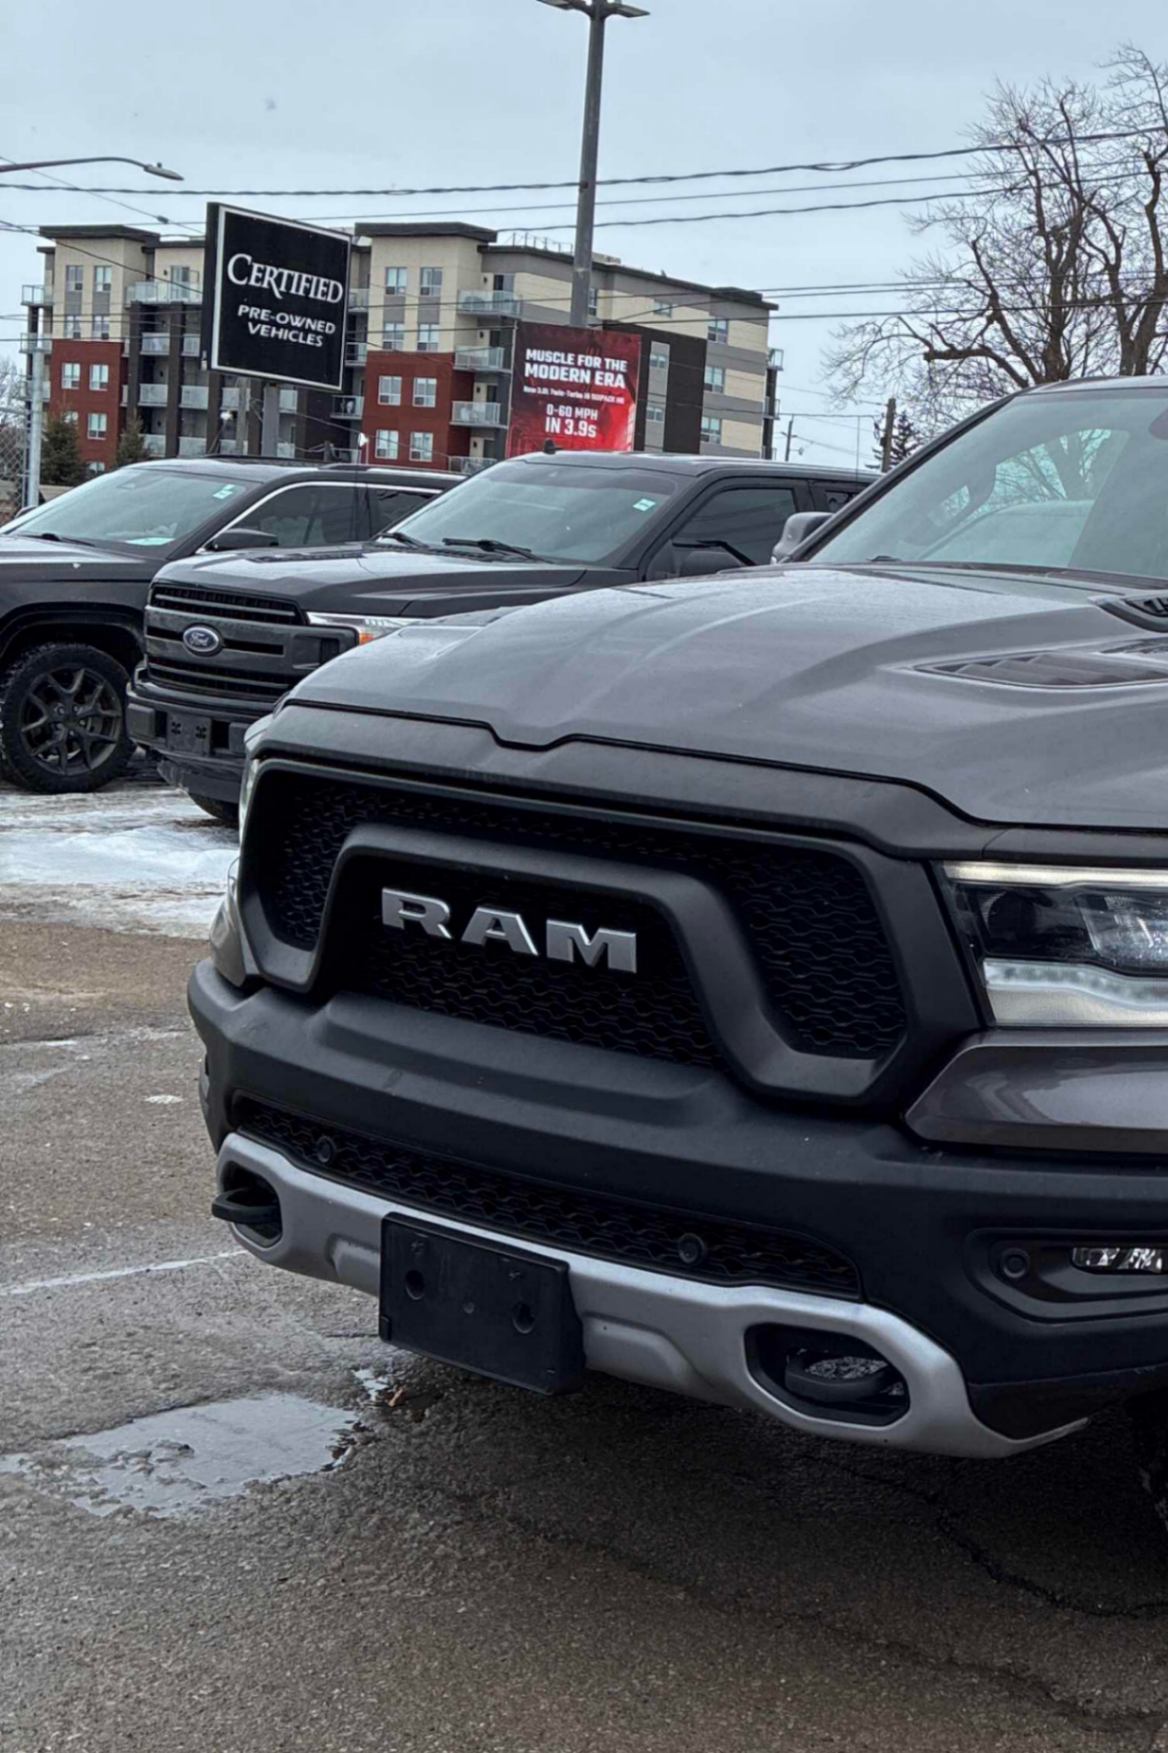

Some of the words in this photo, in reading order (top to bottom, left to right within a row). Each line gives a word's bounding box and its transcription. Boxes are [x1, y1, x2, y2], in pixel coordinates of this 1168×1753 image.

[227, 253, 343, 303] CERTIFIED
[237, 304, 336, 334] PRE-OWNED
[248, 321, 323, 347] VEHICLES
[525, 348, 575, 365] MUSCLE
[577, 354, 602, 368] FOR
[604, 358, 628, 372] THE
[524, 362, 591, 384] MODERN
[594, 370, 626, 389] ERA
[546, 403, 572, 418] 0-60
[574, 407, 598, 420] MPH
[545, 416, 561, 434] IN
[564, 418, 597, 438] 3.9s
[382, 888, 637, 974] RAM
